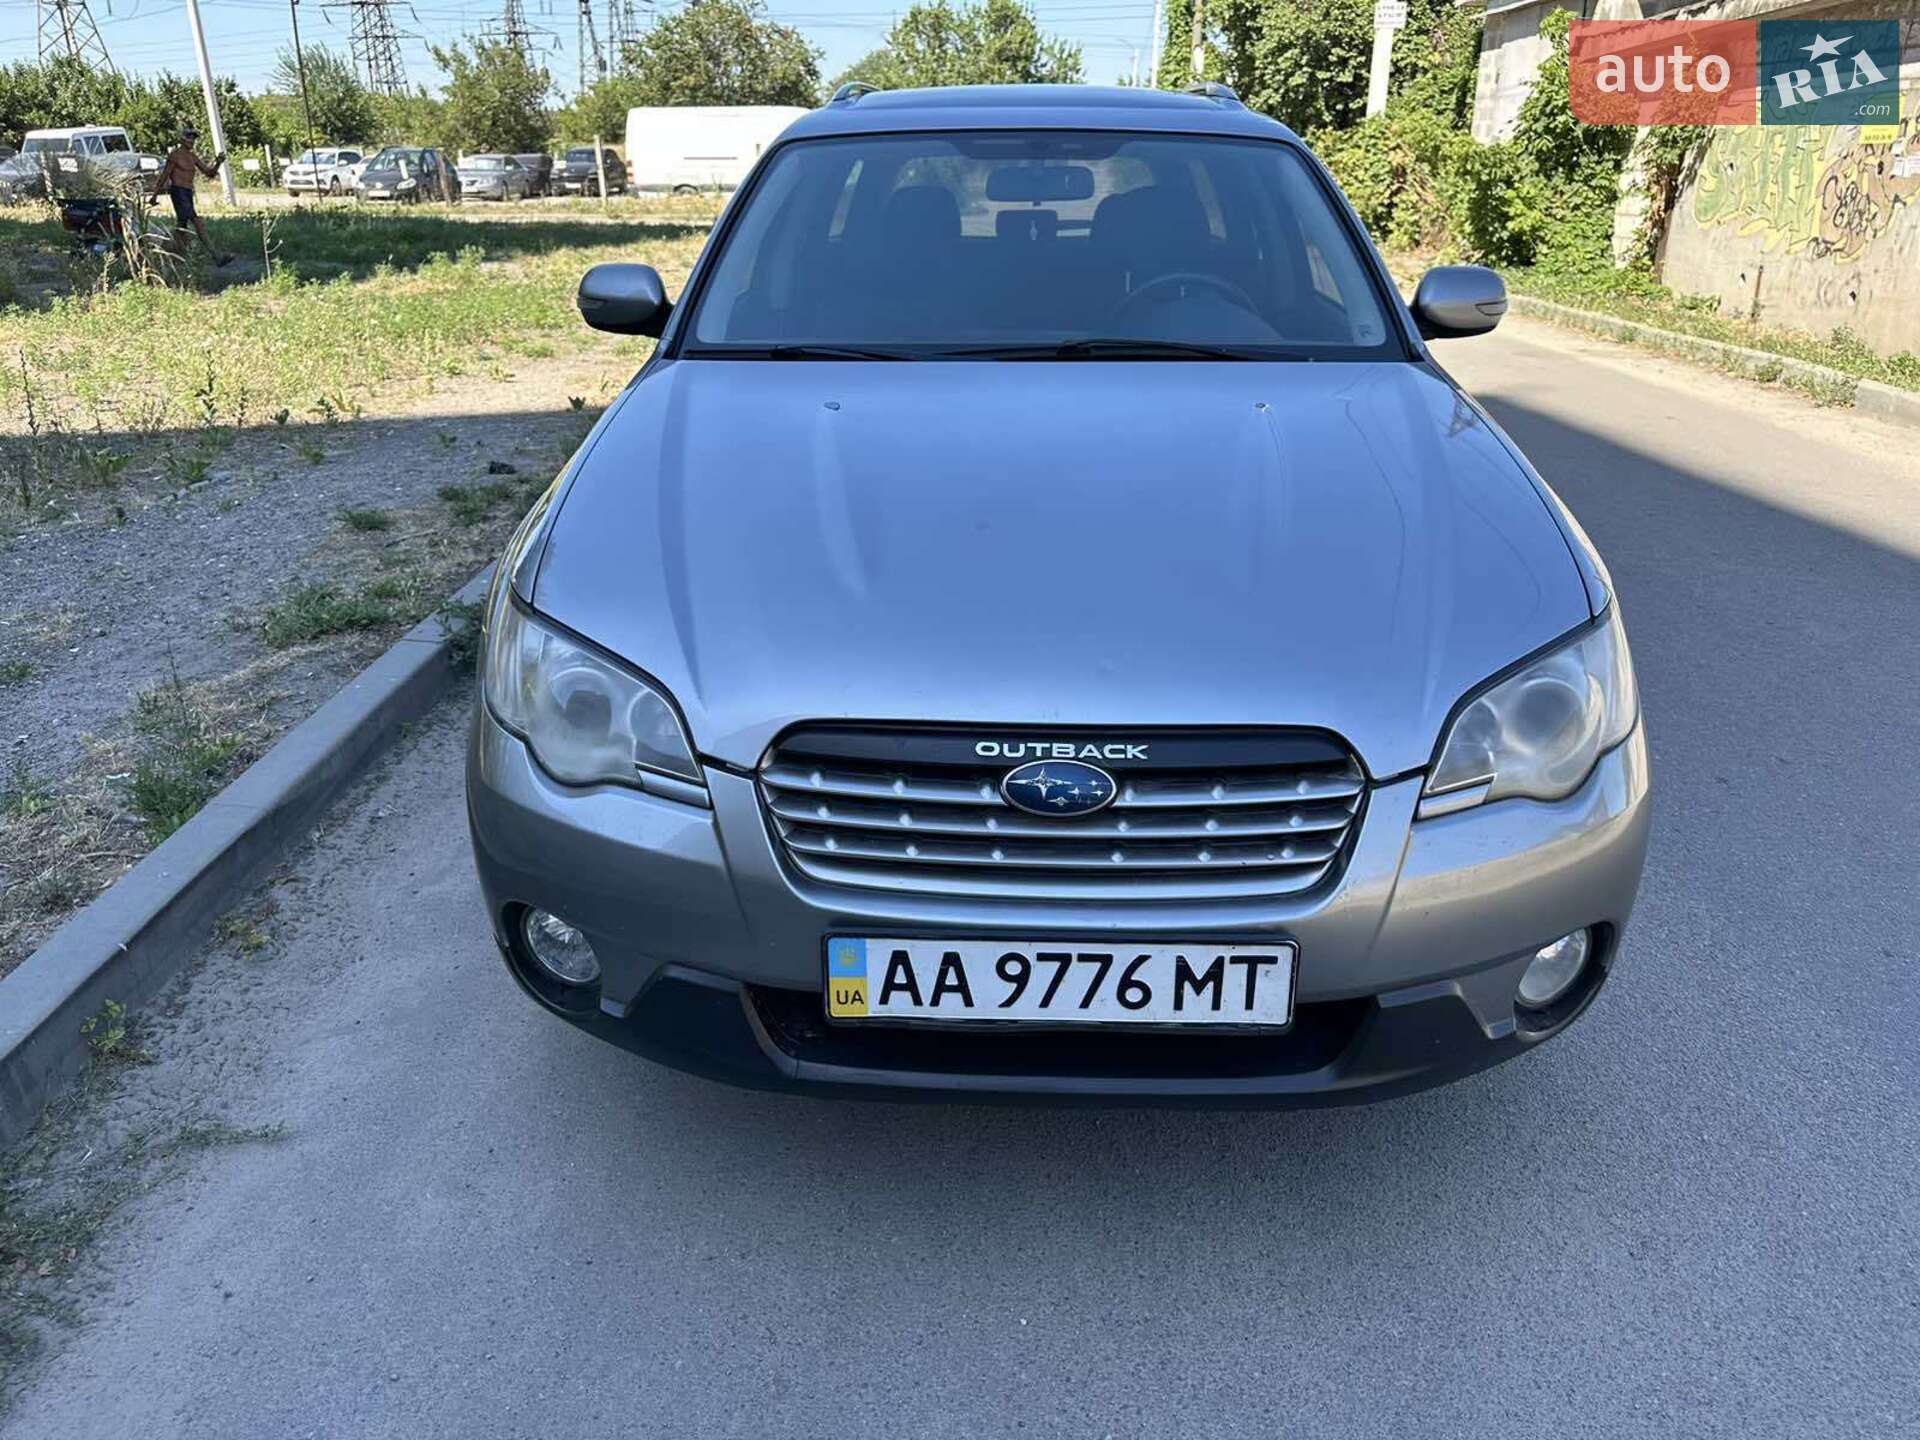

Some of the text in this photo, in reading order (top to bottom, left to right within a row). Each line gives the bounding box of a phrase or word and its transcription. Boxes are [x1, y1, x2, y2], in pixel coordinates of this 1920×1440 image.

[975, 741, 1149, 760] OUTBACK
[879, 950, 1278, 1011] AA 9776 MT
[836, 990, 864, 1005] UA
